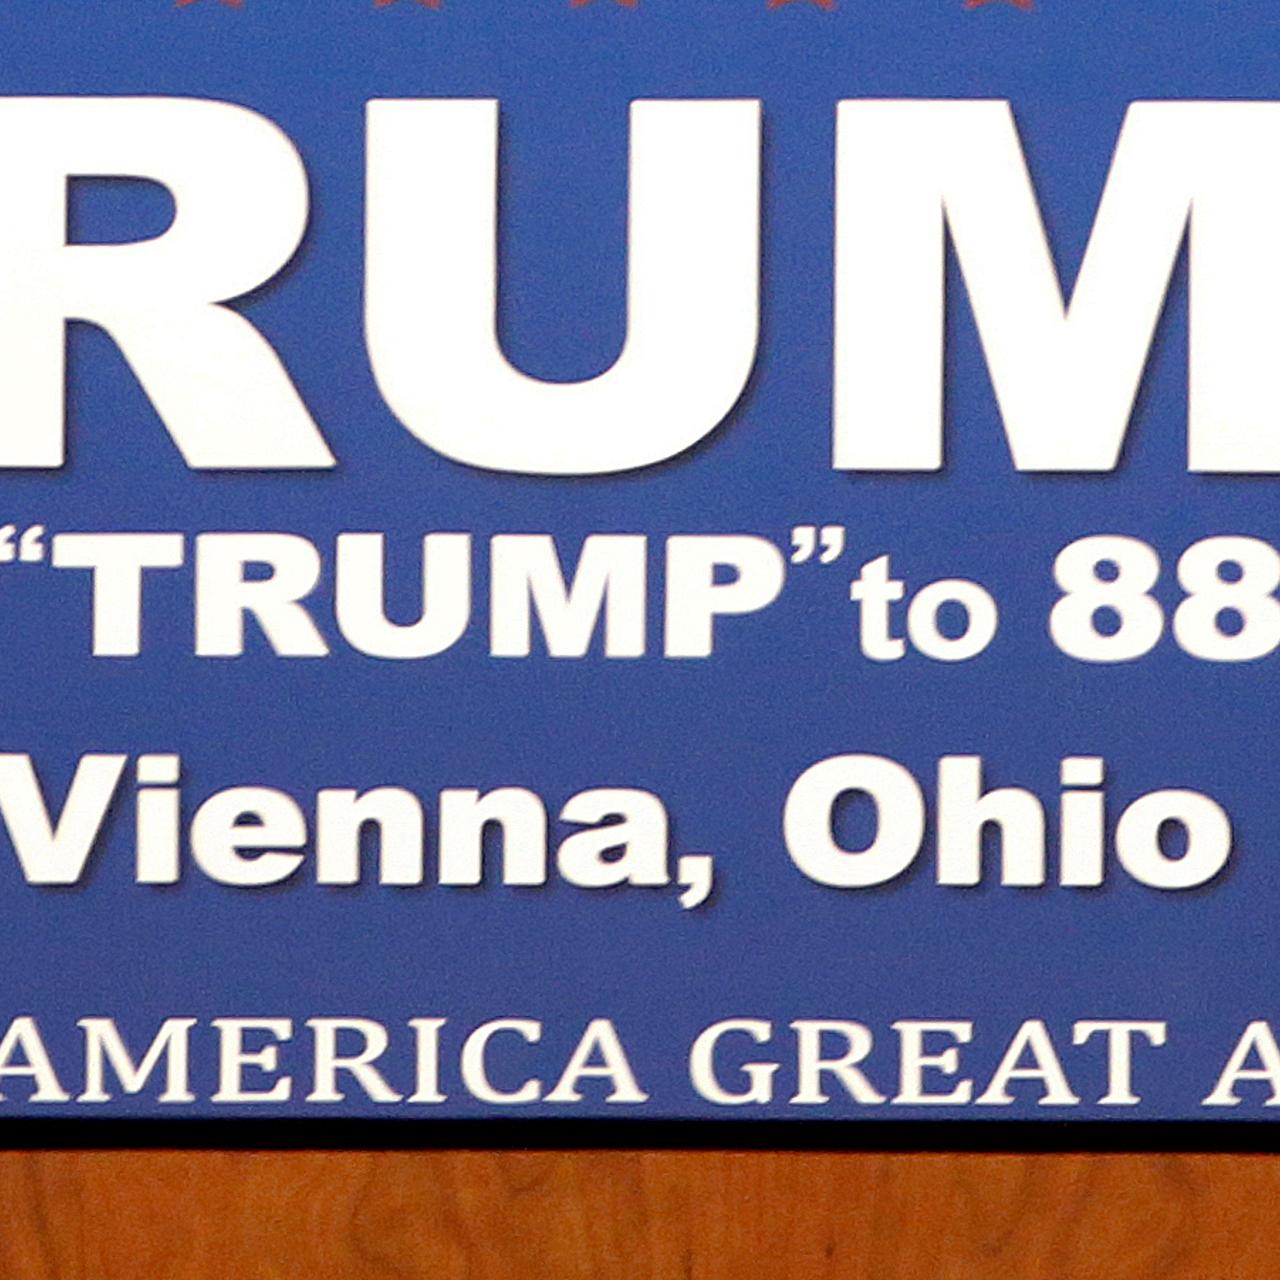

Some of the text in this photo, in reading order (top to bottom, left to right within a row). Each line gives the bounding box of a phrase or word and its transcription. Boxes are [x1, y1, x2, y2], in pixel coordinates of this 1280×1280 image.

[850, 555, 998, 661] to
[783, 754, 1231, 889] Ohio
[689, 1019, 1167, 1105] GREAT
